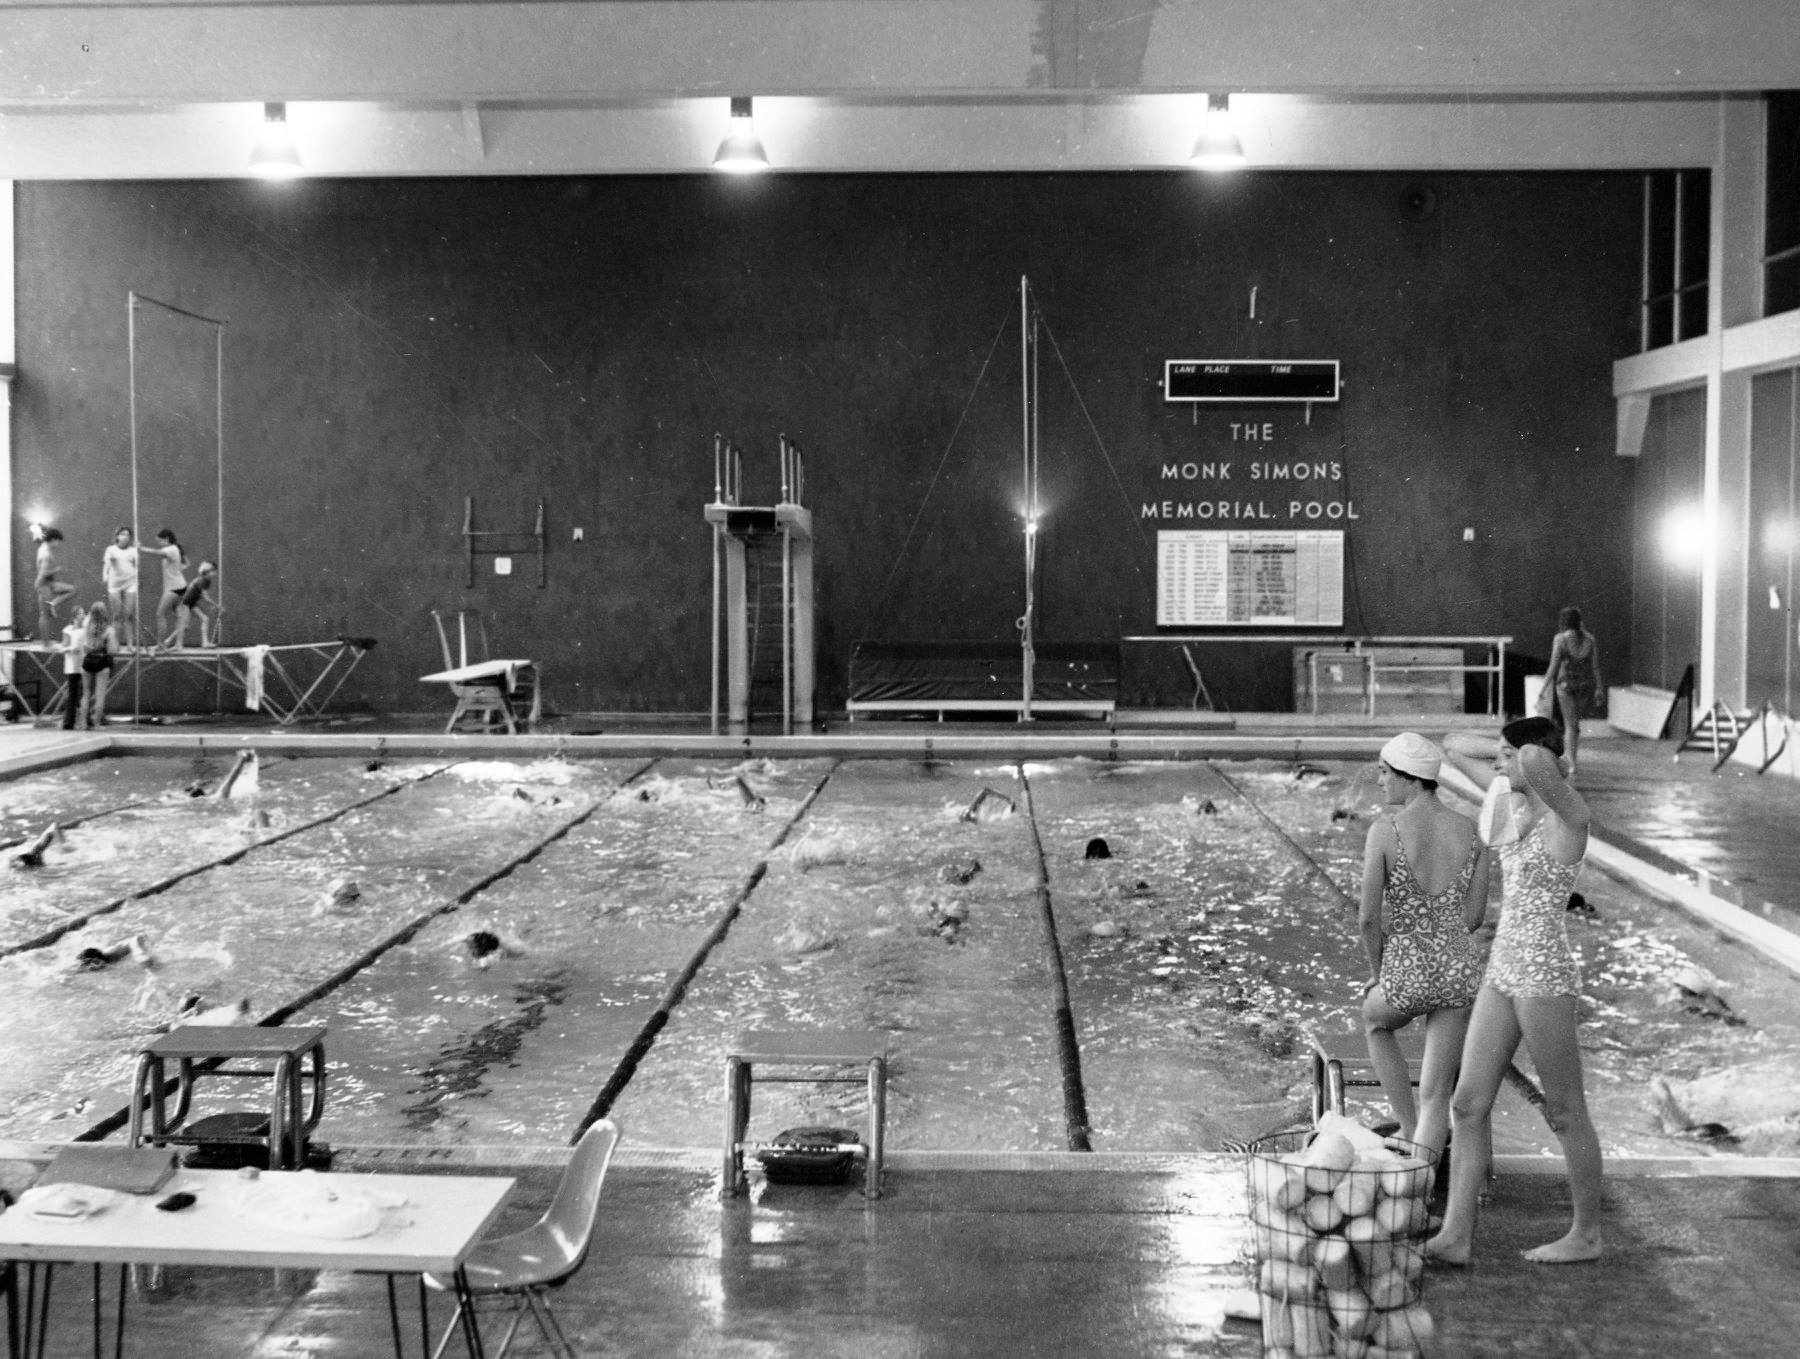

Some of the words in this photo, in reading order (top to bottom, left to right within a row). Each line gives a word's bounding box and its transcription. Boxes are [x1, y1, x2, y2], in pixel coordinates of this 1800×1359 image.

[1174, 365, 1196, 374] LANE
[1204, 365, 1230, 374] PLACE
[1271, 365, 1292, 374] TIME
[1230, 423, 1274, 441] THE
[1161, 462, 1232, 480] MONK
[1141, 501, 1271, 519] MEMORIAL
[1289, 501, 1360, 519] POOL
